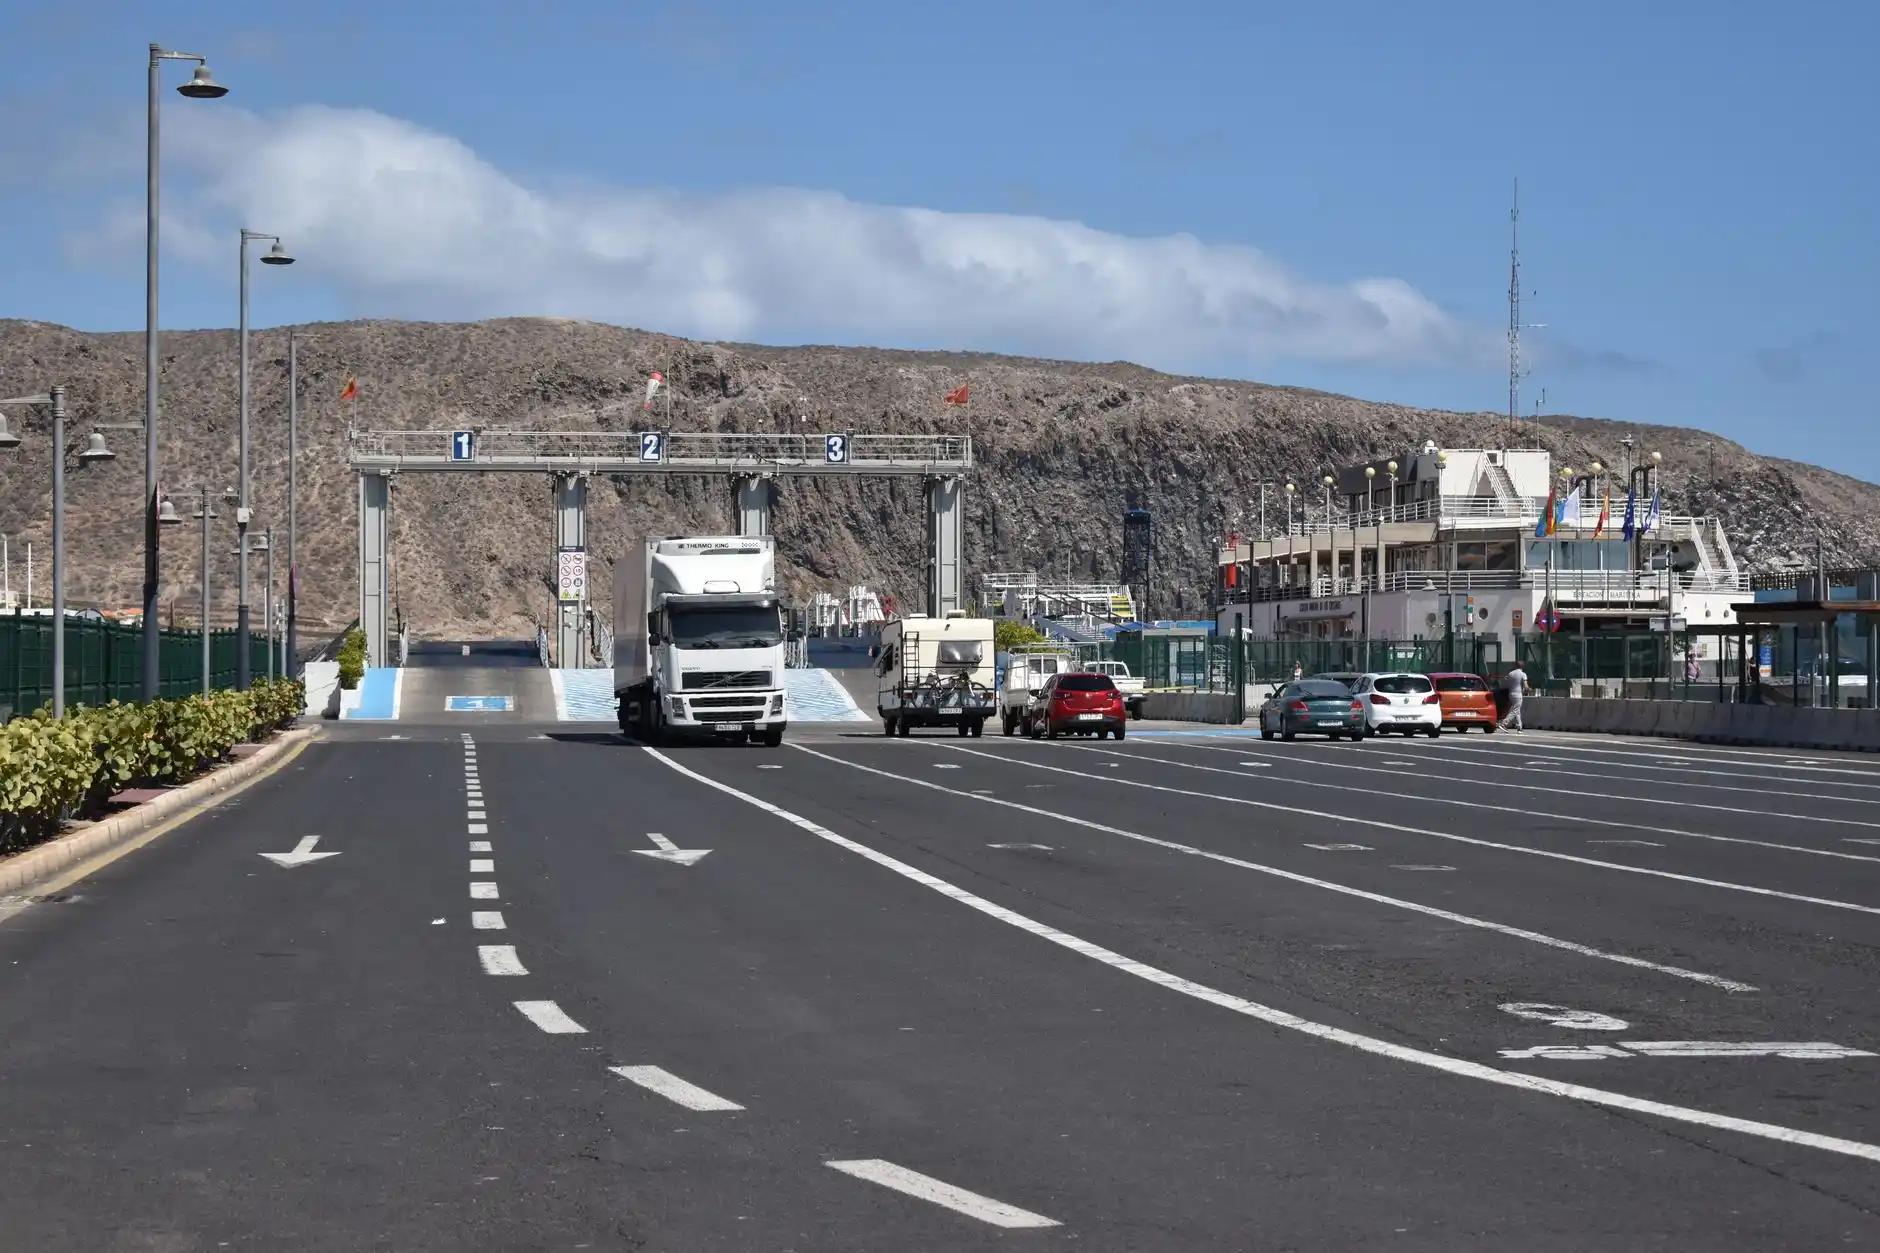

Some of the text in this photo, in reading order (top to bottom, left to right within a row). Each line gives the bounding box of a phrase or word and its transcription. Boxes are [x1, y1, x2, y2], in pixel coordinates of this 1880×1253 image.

[457, 433, 469, 458] 1
[643, 434, 659, 460] 2
[828, 436, 844, 462] 3
